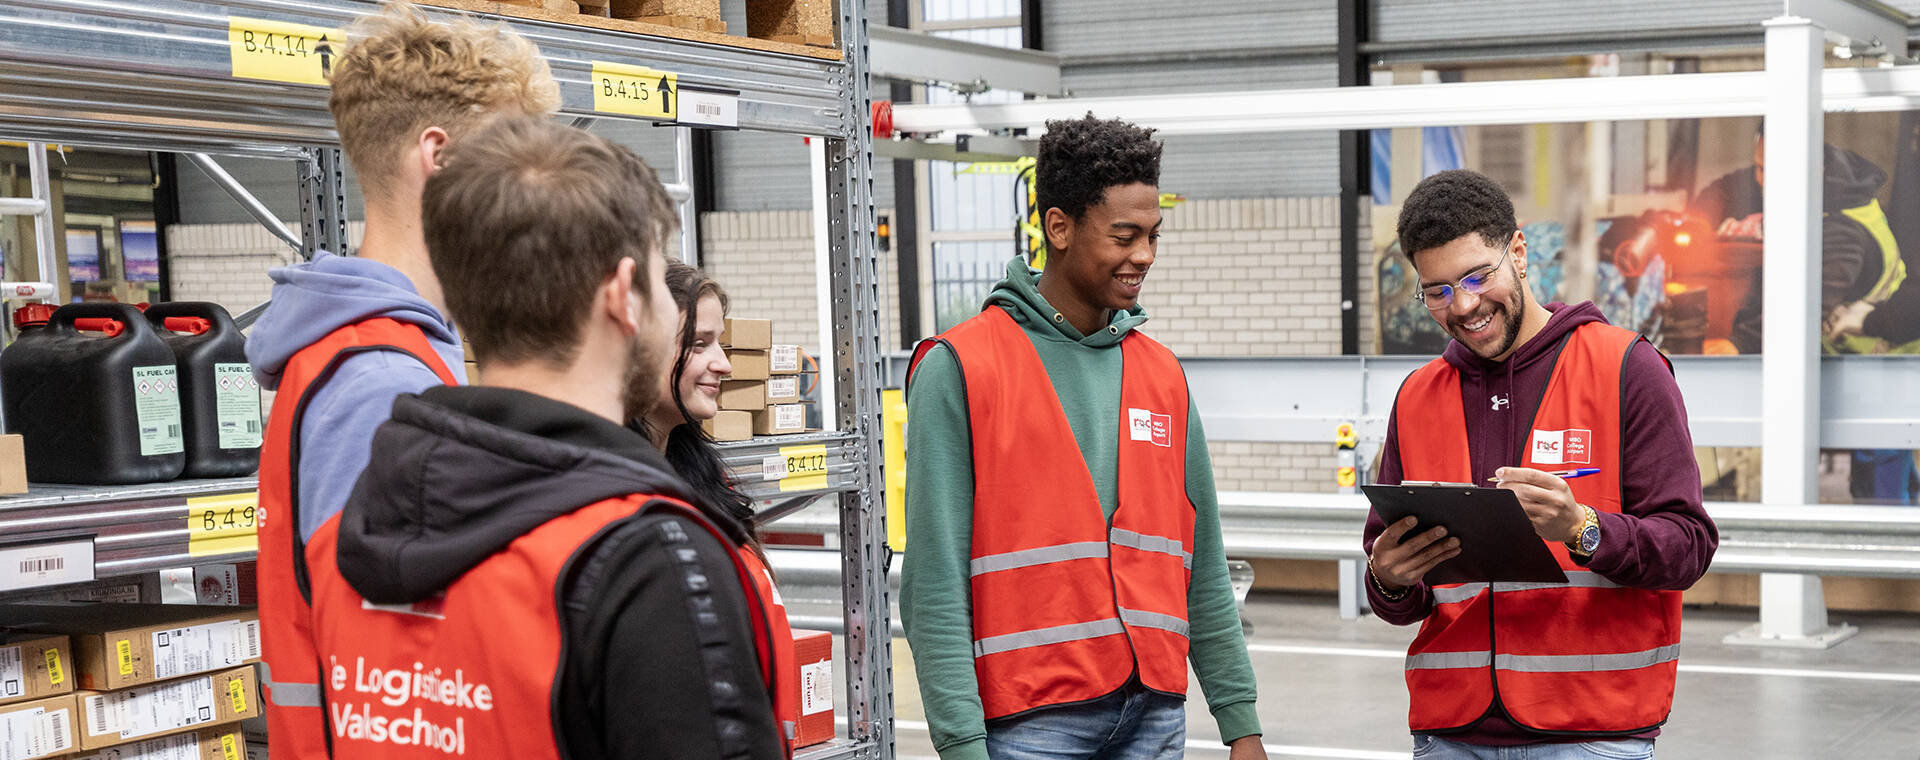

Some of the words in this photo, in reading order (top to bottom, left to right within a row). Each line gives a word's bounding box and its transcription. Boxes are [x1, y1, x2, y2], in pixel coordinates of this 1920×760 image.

[244, 30, 307, 57] B.4.14
[603, 78, 649, 100] B.4.15
[787, 455, 825, 473] B.4.12
[203, 506, 255, 531] B.4.9
